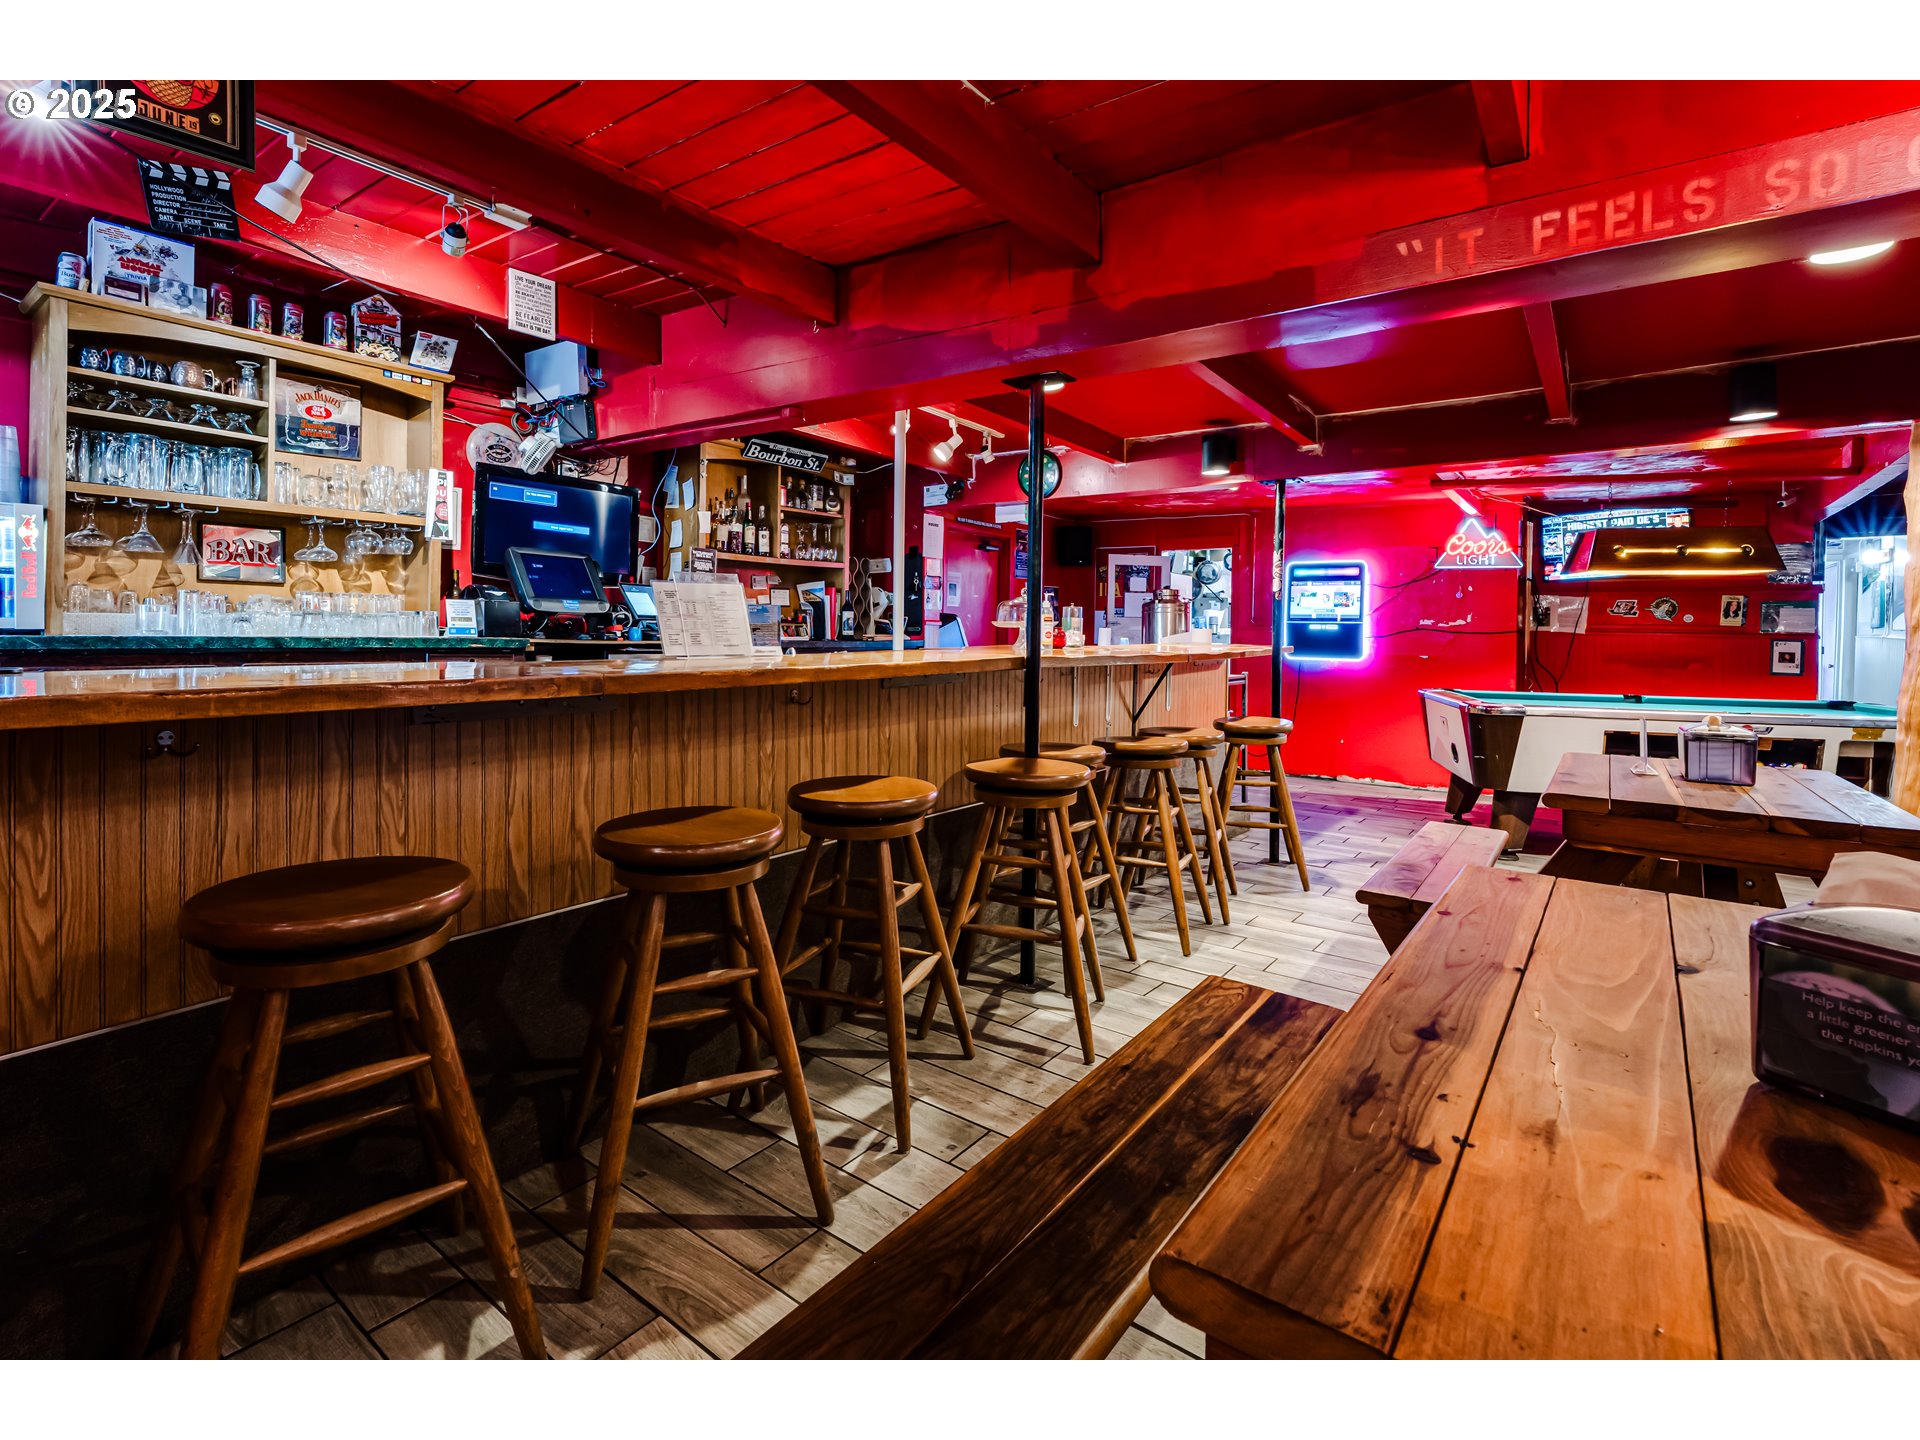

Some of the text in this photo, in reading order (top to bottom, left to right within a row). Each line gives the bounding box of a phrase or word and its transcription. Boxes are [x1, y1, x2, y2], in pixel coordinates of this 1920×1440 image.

[138, 102, 187, 129] JUNE
[149, 184, 184, 194] HOLLYWOOD
[151, 191, 187, 202] PRODUCTION
[153, 199, 181, 208] DIRECTOR
[154, 207, 178, 215] CAMERA
[1532, 177, 1716, 255] FEELS
[1764, 149, 1849, 207] SO
[515, 275, 552, 291] LIVE YOUR DREAM
[515, 310, 522, 318] BE
[523, 313, 552, 326] FEARLESS
[296, 392, 313, 404] JACK
[747, 444, 820, 471] Bourbon St.
[1611, 517, 1635, 528] PAID
[1637, 514, 1660, 525] DE'S
[207, 538, 278, 568] BAR
[1447, 533, 1512, 555] Coors
[1456, 554, 1498, 565] LIGHT
[21, 552, 37, 598] Red Bull
[1802, 991, 1835, 1010] Help
[1840, 1001, 1873, 1021] keep
[1878, 1014, 1902, 1028] the
[1807, 1010, 1913, 1047] a little greener
[1821, 1029, 1845, 1043] the
[1848, 1039, 1903, 1061] napkins
